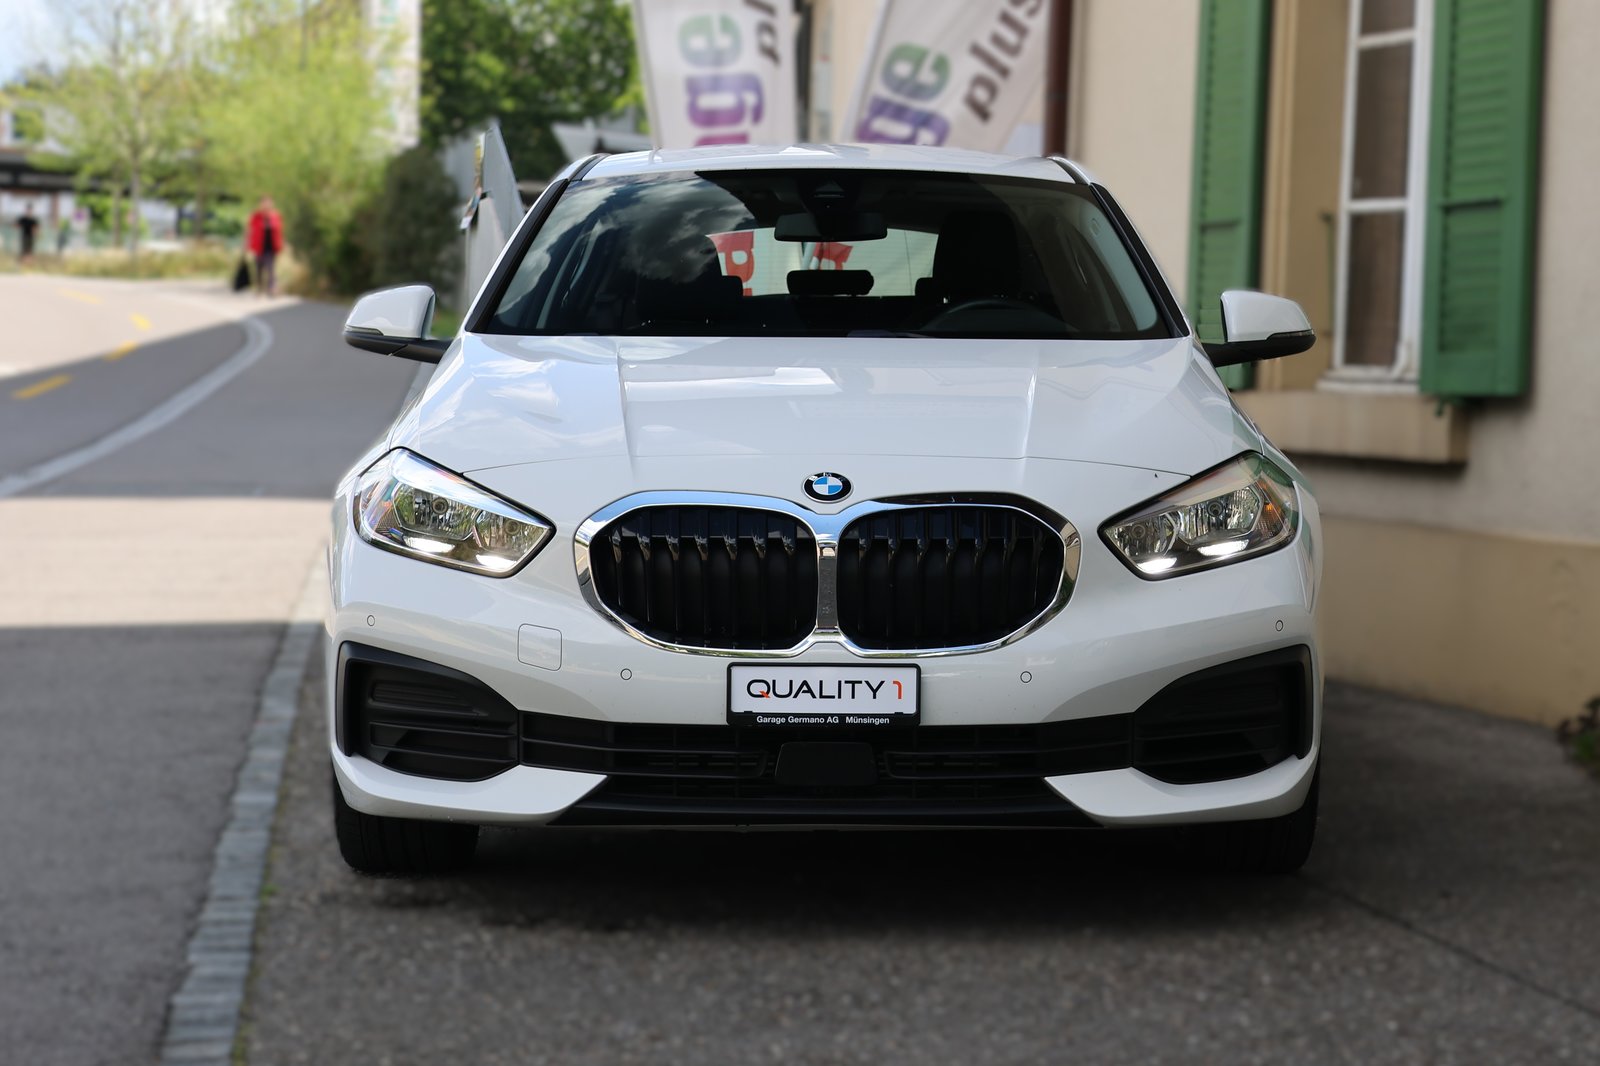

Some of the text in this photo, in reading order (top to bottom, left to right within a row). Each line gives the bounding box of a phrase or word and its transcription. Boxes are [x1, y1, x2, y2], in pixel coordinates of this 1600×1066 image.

[746, 679, 903, 700] QUALITY 1
[756, 716, 890, 725] Garage Germano AG Münsingen
